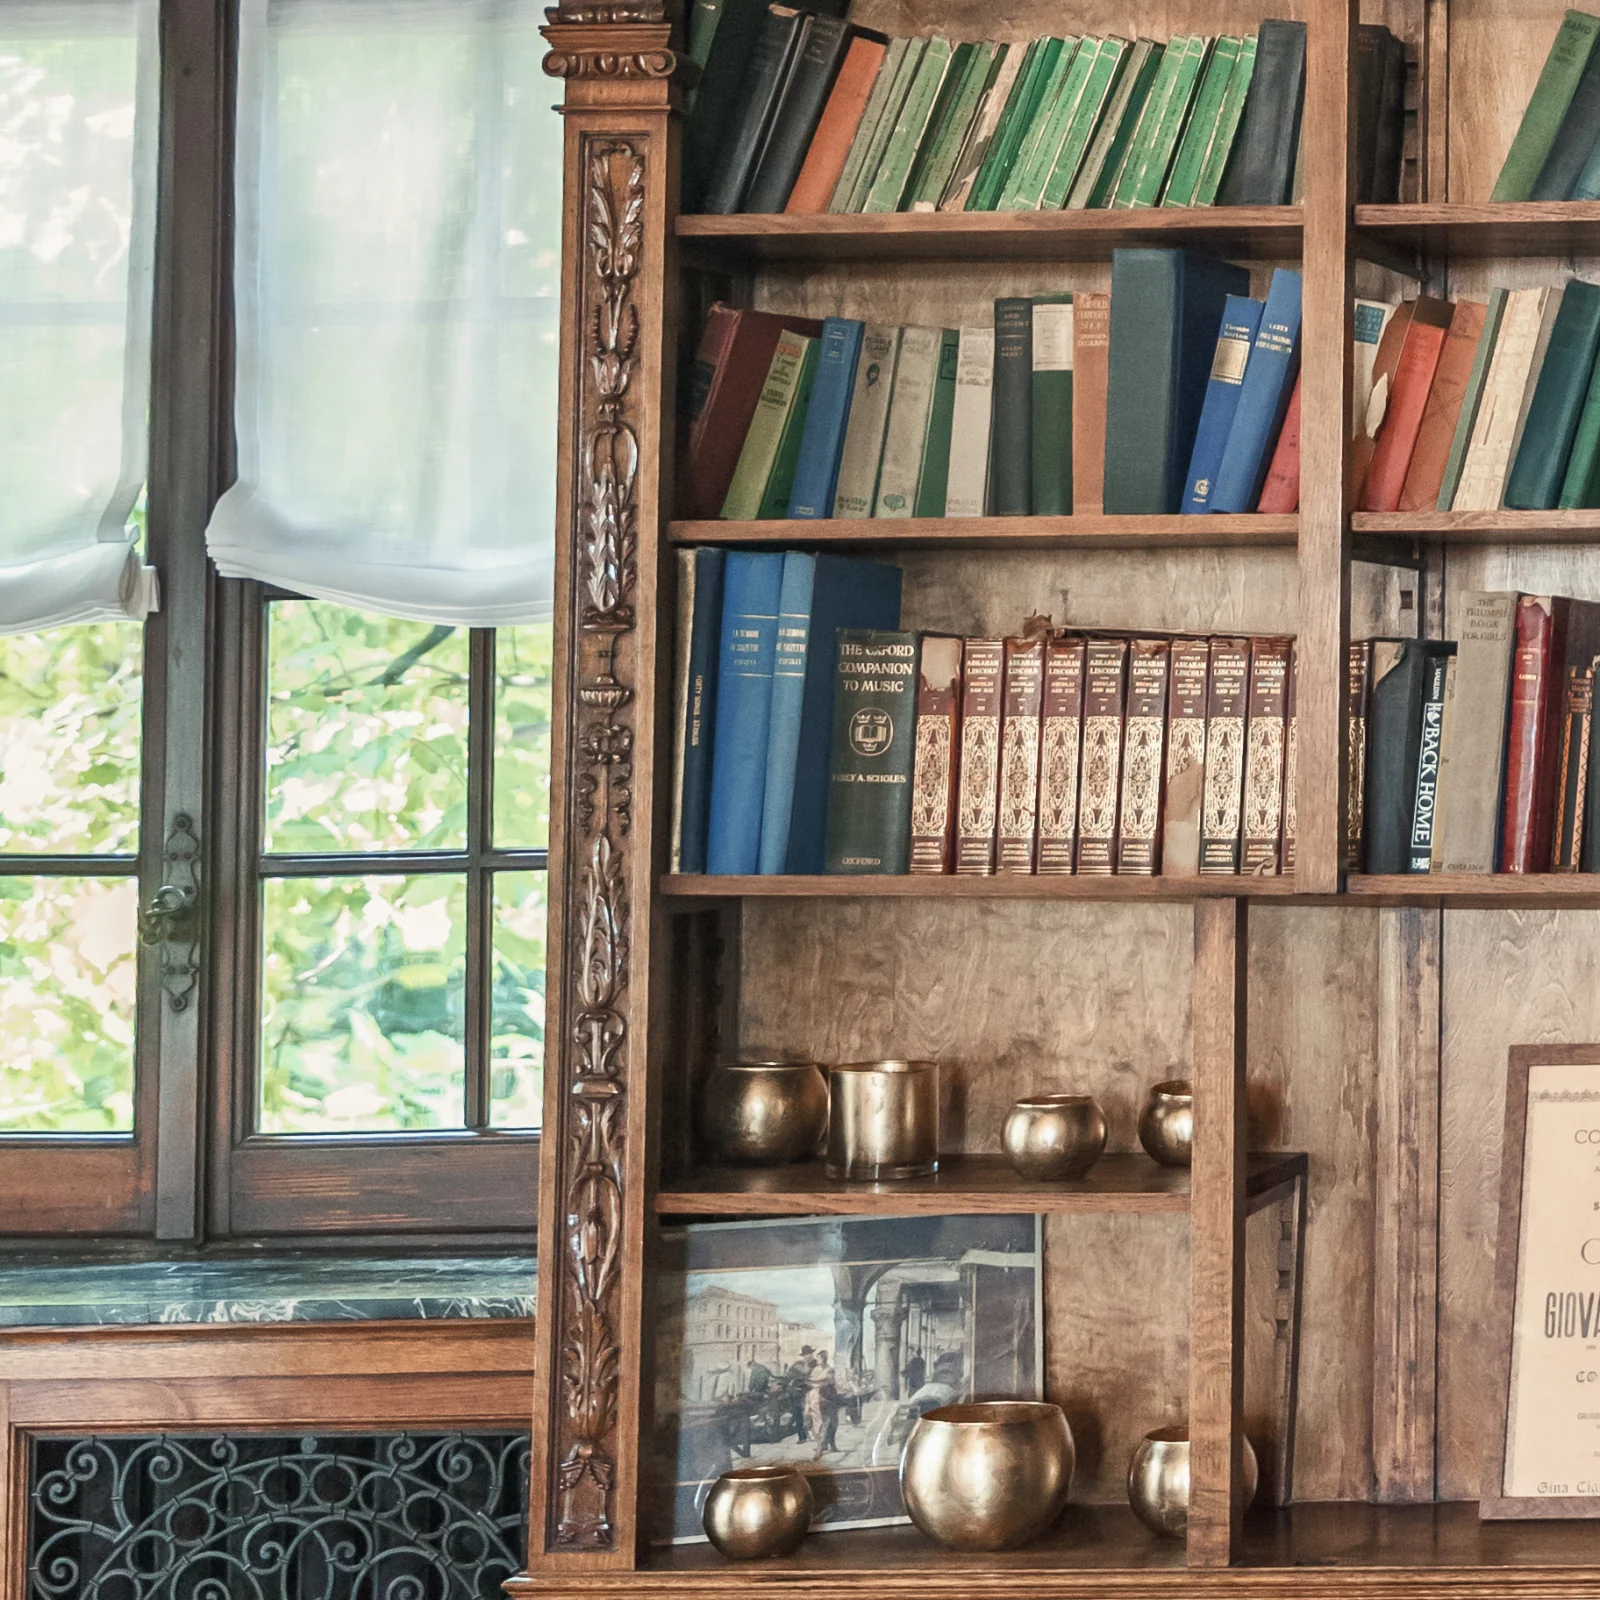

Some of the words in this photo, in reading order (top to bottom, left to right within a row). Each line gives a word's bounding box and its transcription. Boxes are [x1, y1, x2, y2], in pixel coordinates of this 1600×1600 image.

[1477, 599, 1495, 607] THE
[1470, 619, 1499, 628] BOOK
[839, 644, 862, 657] THE
[838, 661, 914, 675] COMPANION
[843, 680, 859, 692] TO
[861, 680, 904, 692] MUSIC
[1419, 726, 1440, 778] BACK
[866, 774, 907, 783] SCHOLES
[1414, 781, 1436, 843] HOME
[842, 857, 881, 866] OXFORD
[1537, 1481, 1569, 1493] Gina
